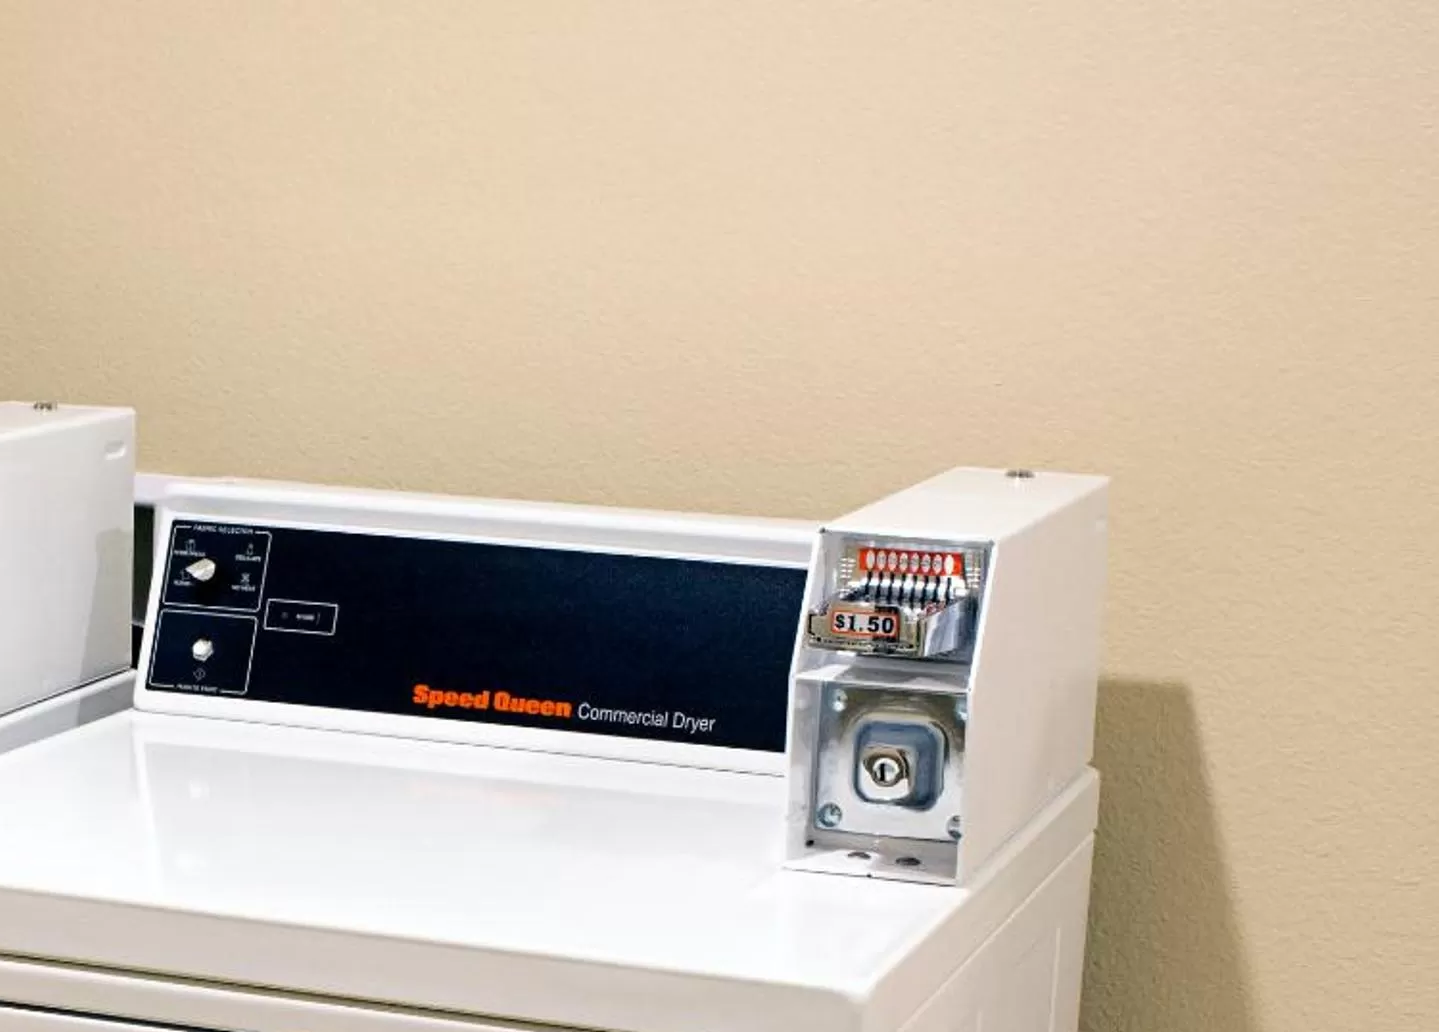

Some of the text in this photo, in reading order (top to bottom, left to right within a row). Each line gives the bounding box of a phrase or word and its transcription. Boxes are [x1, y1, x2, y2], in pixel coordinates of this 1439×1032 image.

[834, 613, 894, 633] $1.50
[413, 684, 716, 735] Speed Queen Commercial Dryer
